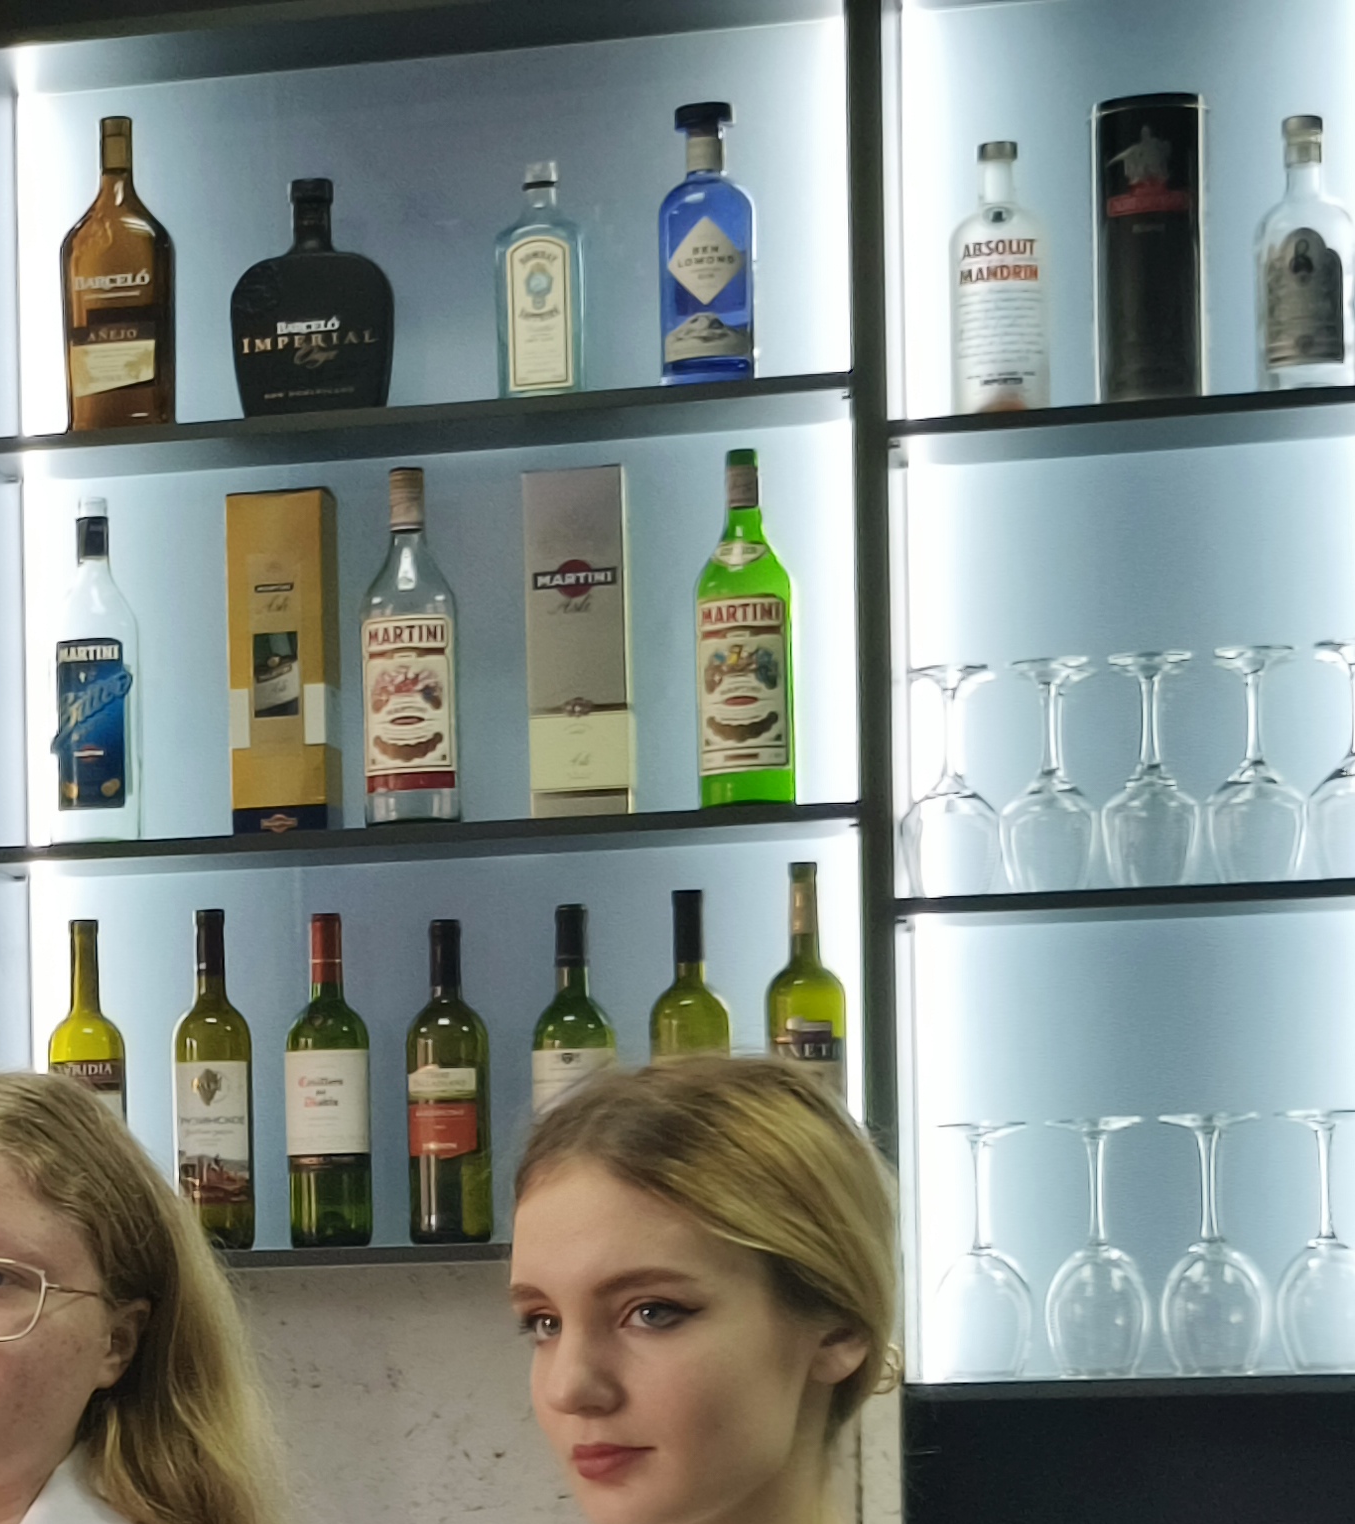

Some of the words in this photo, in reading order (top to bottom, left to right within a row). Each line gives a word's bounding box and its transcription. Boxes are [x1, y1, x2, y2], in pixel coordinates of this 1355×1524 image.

[692, 246, 719, 256] BEN
[962, 239, 1036, 261] ABSOLUT
[677, 255, 735, 269] LOMOND
[75, 268, 150, 290] BARCELÓ
[959, 264, 1039, 285] MANDRIN
[88, 327, 138, 342] AÑEJO
[242, 329, 376, 354] IMPERIAL
[537, 571, 613, 588] MARTINI
[701, 602, 781, 626] MARTINI
[368, 623, 445, 647] MARTINI
[58, 644, 120, 663] MARTINI
